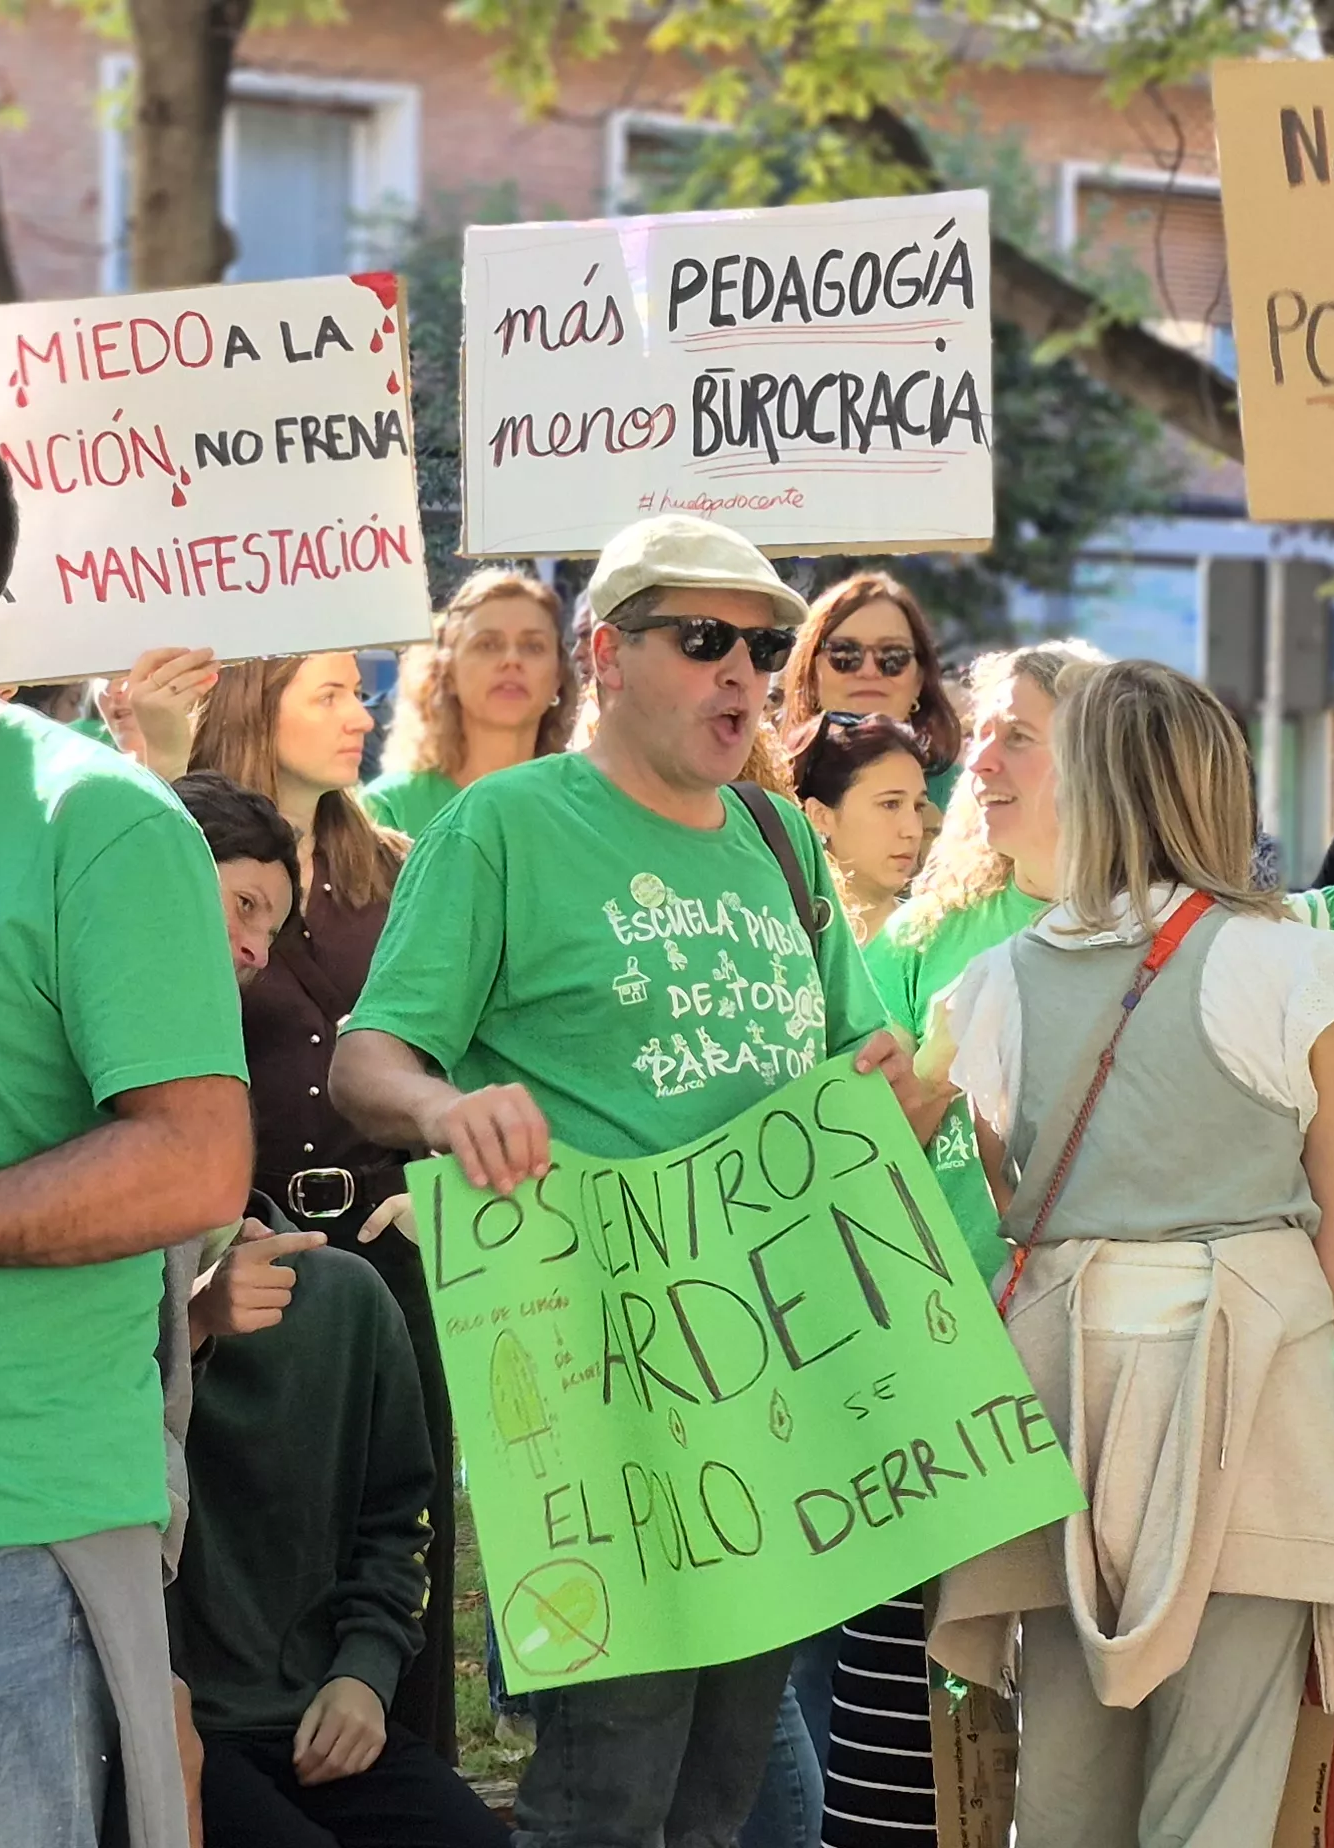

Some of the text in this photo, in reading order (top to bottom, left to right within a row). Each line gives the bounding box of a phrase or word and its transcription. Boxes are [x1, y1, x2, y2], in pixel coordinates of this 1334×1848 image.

[493, 216, 975, 358] más PEDAGOGÍA
[15, 310, 214, 386] MIEDO
[223, 325, 261, 369] A
[279, 314, 355, 364] LA
[488, 336, 991, 469] menos BUROCRACIA
[5, 407, 410, 495] NCIÓN NO FRENA
[55, 512, 415, 606] MANIFESTACIÓN
[611, 898, 740, 946] ESCUELA
[667, 976, 826, 1028] DE TOD@S
[650, 1042, 760, 1087] PARA
[432, 1078, 880, 1290] LOS CENTROS
[601, 1161, 954, 1413] ARDEN
[843, 1372, 898, 1420] SE
[544, 1393, 1061, 1586] EL POLO DERRITE
